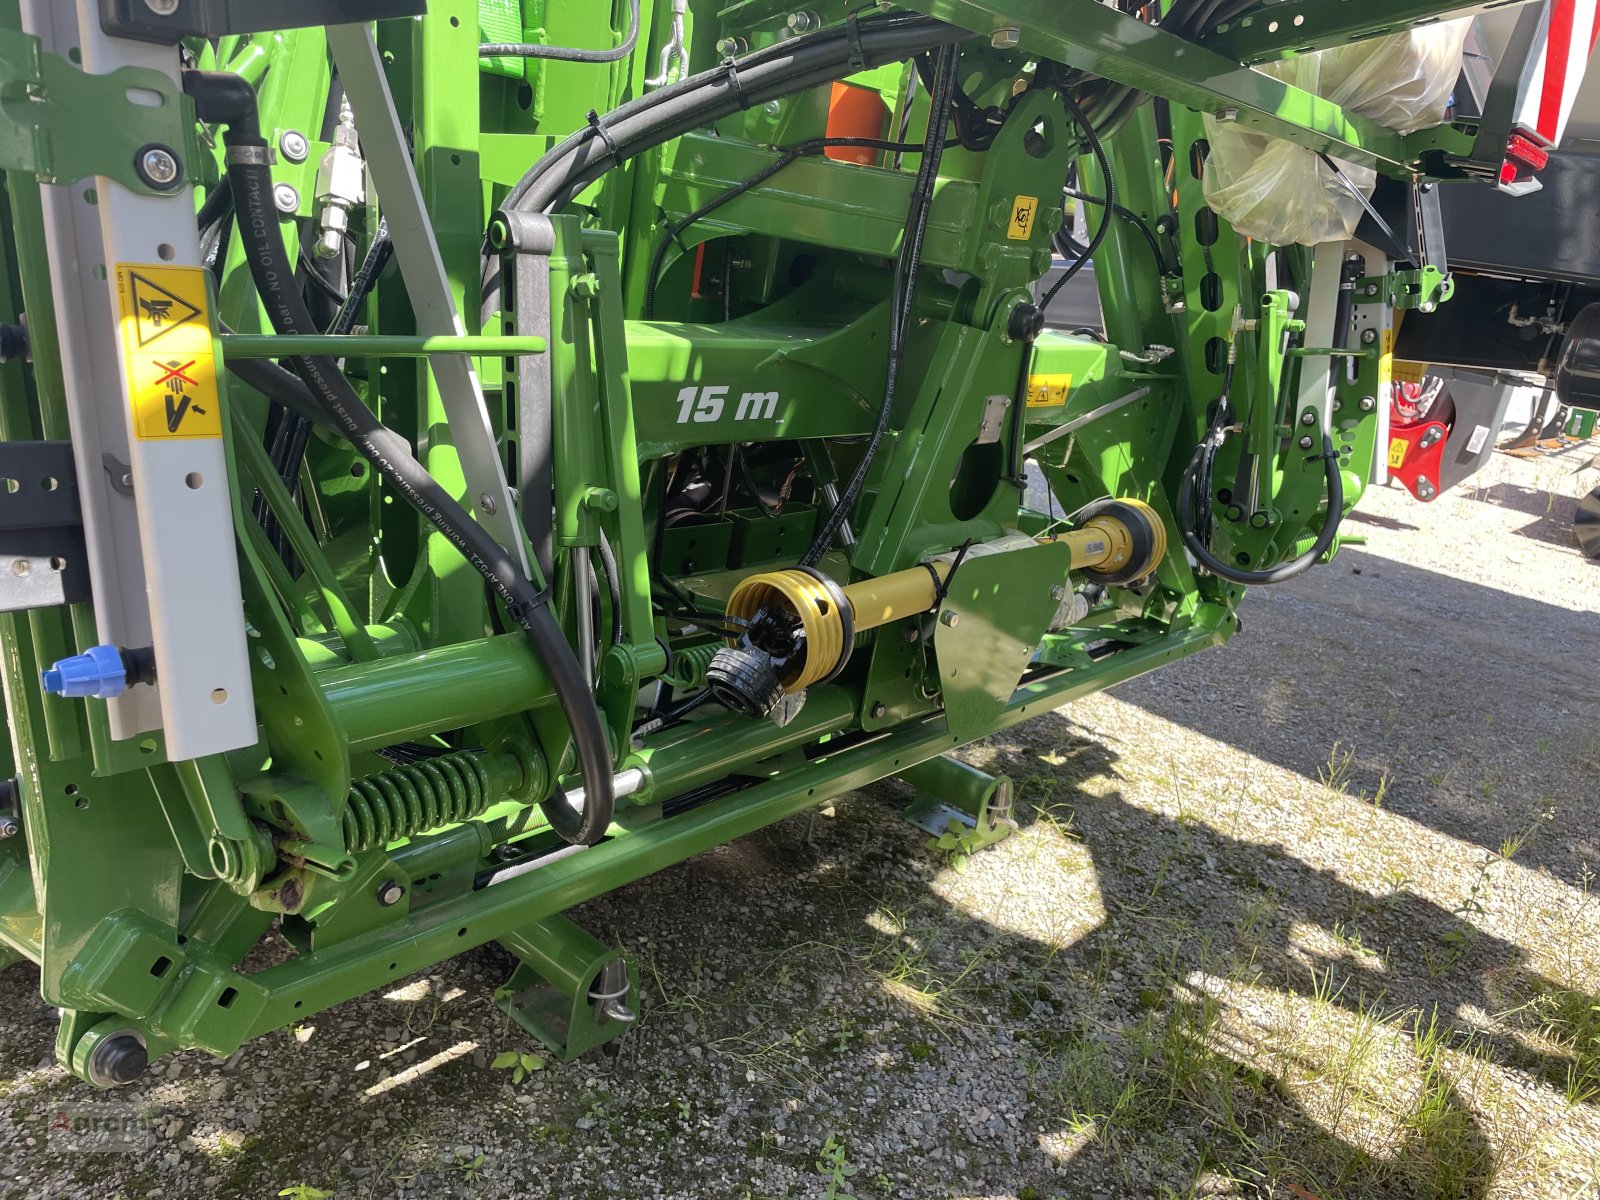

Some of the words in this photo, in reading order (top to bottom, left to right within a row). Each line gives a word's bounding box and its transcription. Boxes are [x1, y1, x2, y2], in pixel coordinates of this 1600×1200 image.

[257, 242, 273, 266] OIL
[264, 271, 281, 292] NO
[277, 301, 293, 325] bar
[676, 385, 730, 424] 15
[734, 391, 780, 421] m
[332, 402, 358, 432] burst
[363, 440, 380, 457] bar
[377, 458, 394, 473] 20
[432, 511, 466, 548] working
[470, 552, 499, 583] AP521
